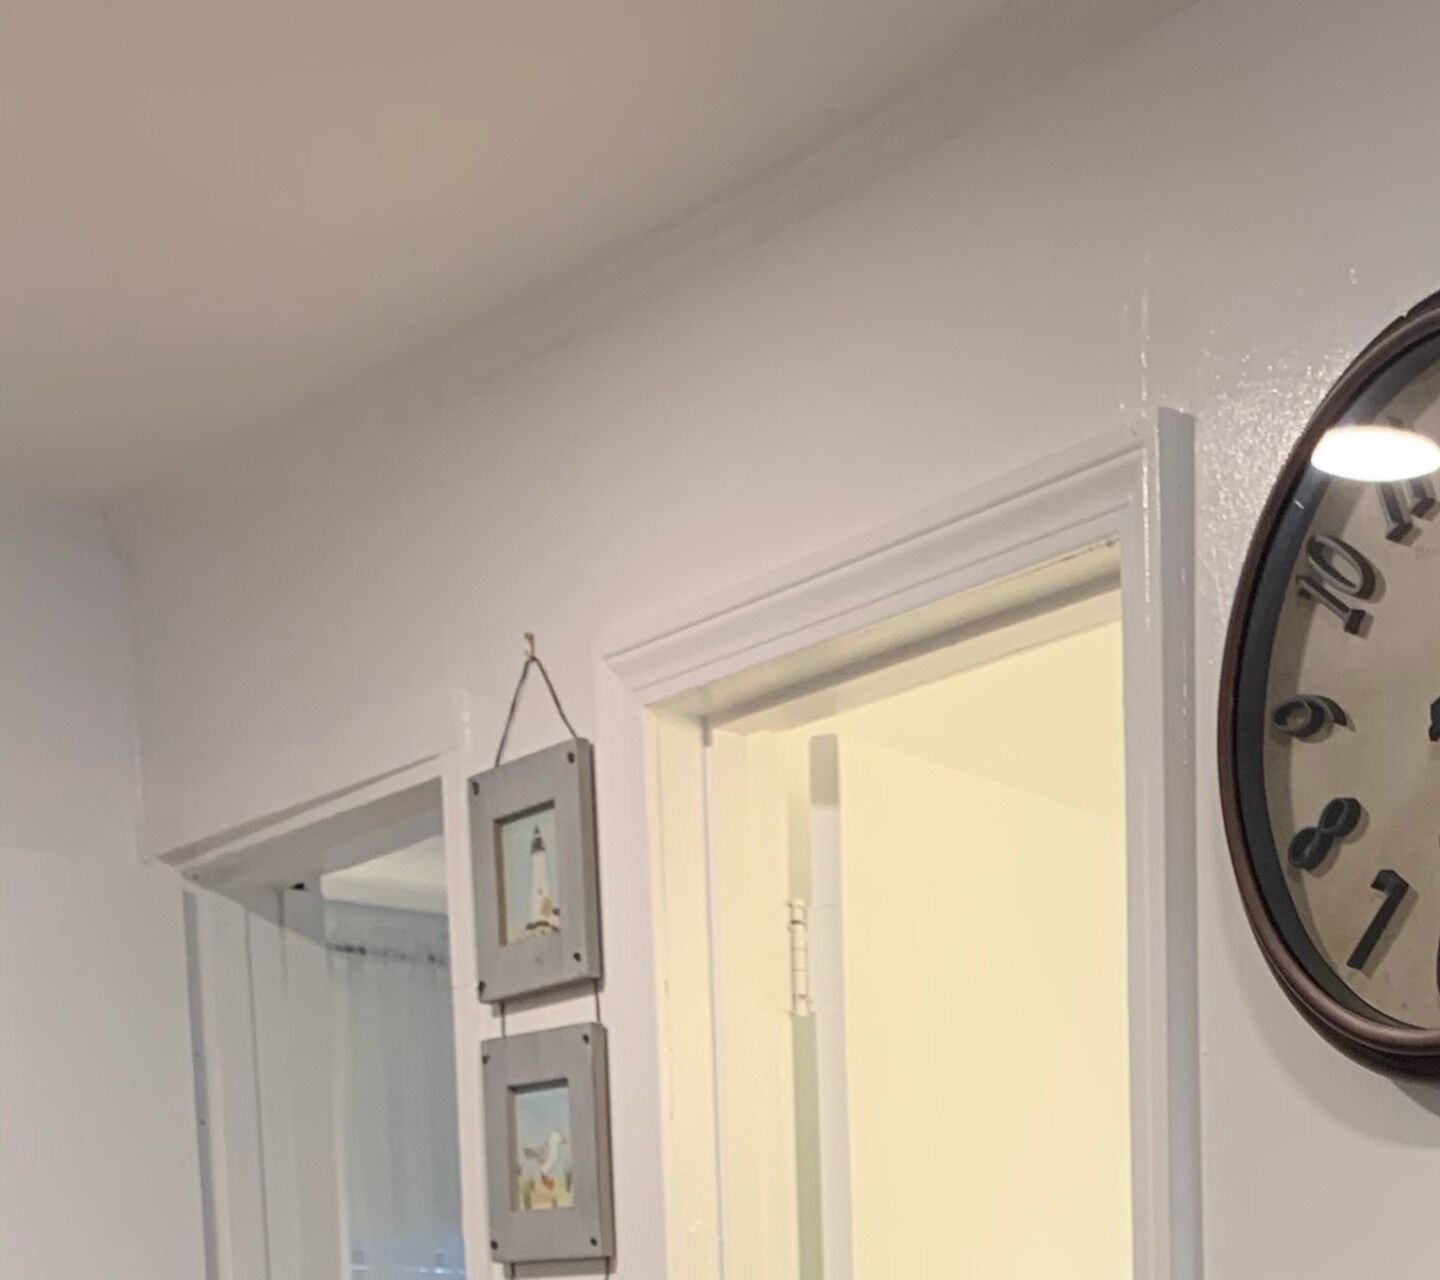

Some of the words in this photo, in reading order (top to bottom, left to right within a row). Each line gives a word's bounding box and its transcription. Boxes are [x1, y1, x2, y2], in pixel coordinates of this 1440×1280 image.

[1297, 533, 1385, 634] 10
[1273, 694, 1347, 739] 9
[1288, 797, 1362, 872] 8
[1347, 869, 1409, 969] 7
